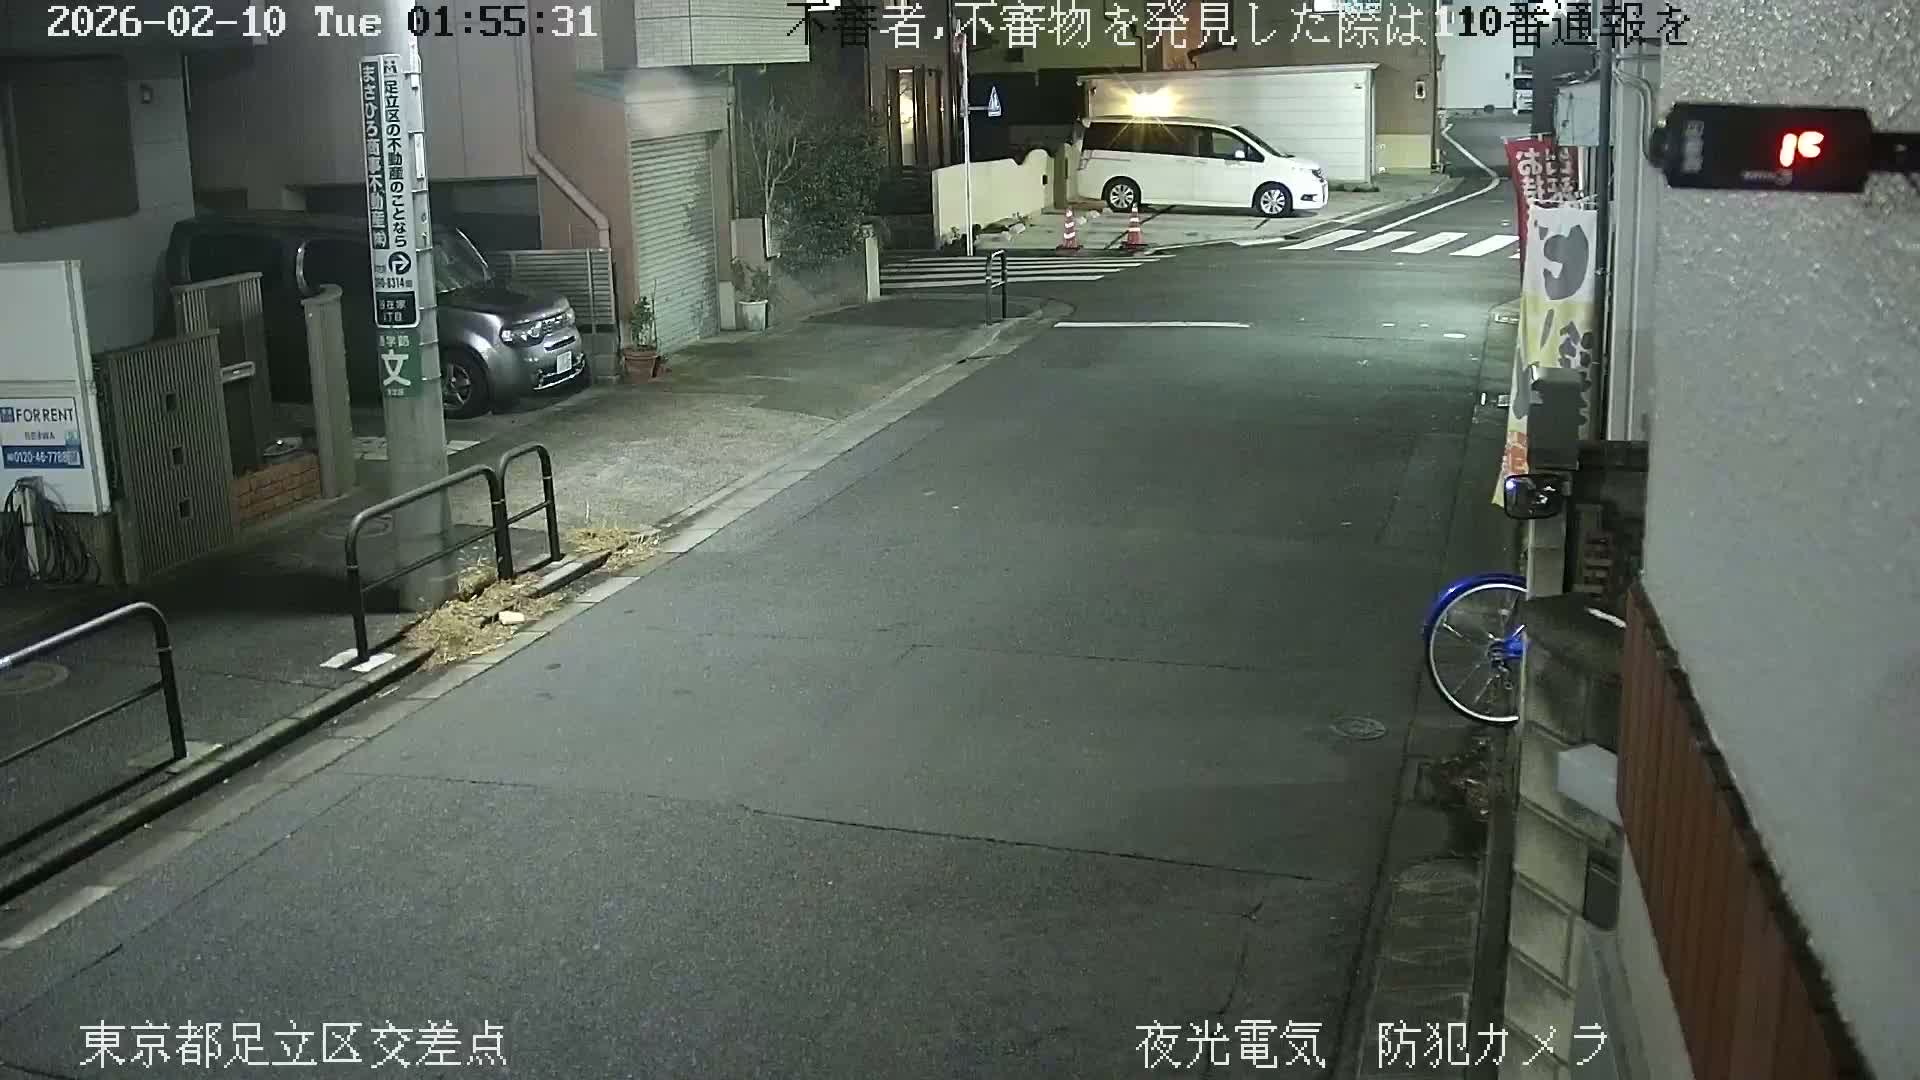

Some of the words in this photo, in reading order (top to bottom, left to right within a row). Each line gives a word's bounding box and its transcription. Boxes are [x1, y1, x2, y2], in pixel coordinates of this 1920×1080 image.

[381, 349, 411, 386] 文
[16, 408, 40, 423] FOR
[42, 408, 73, 423] RENT
